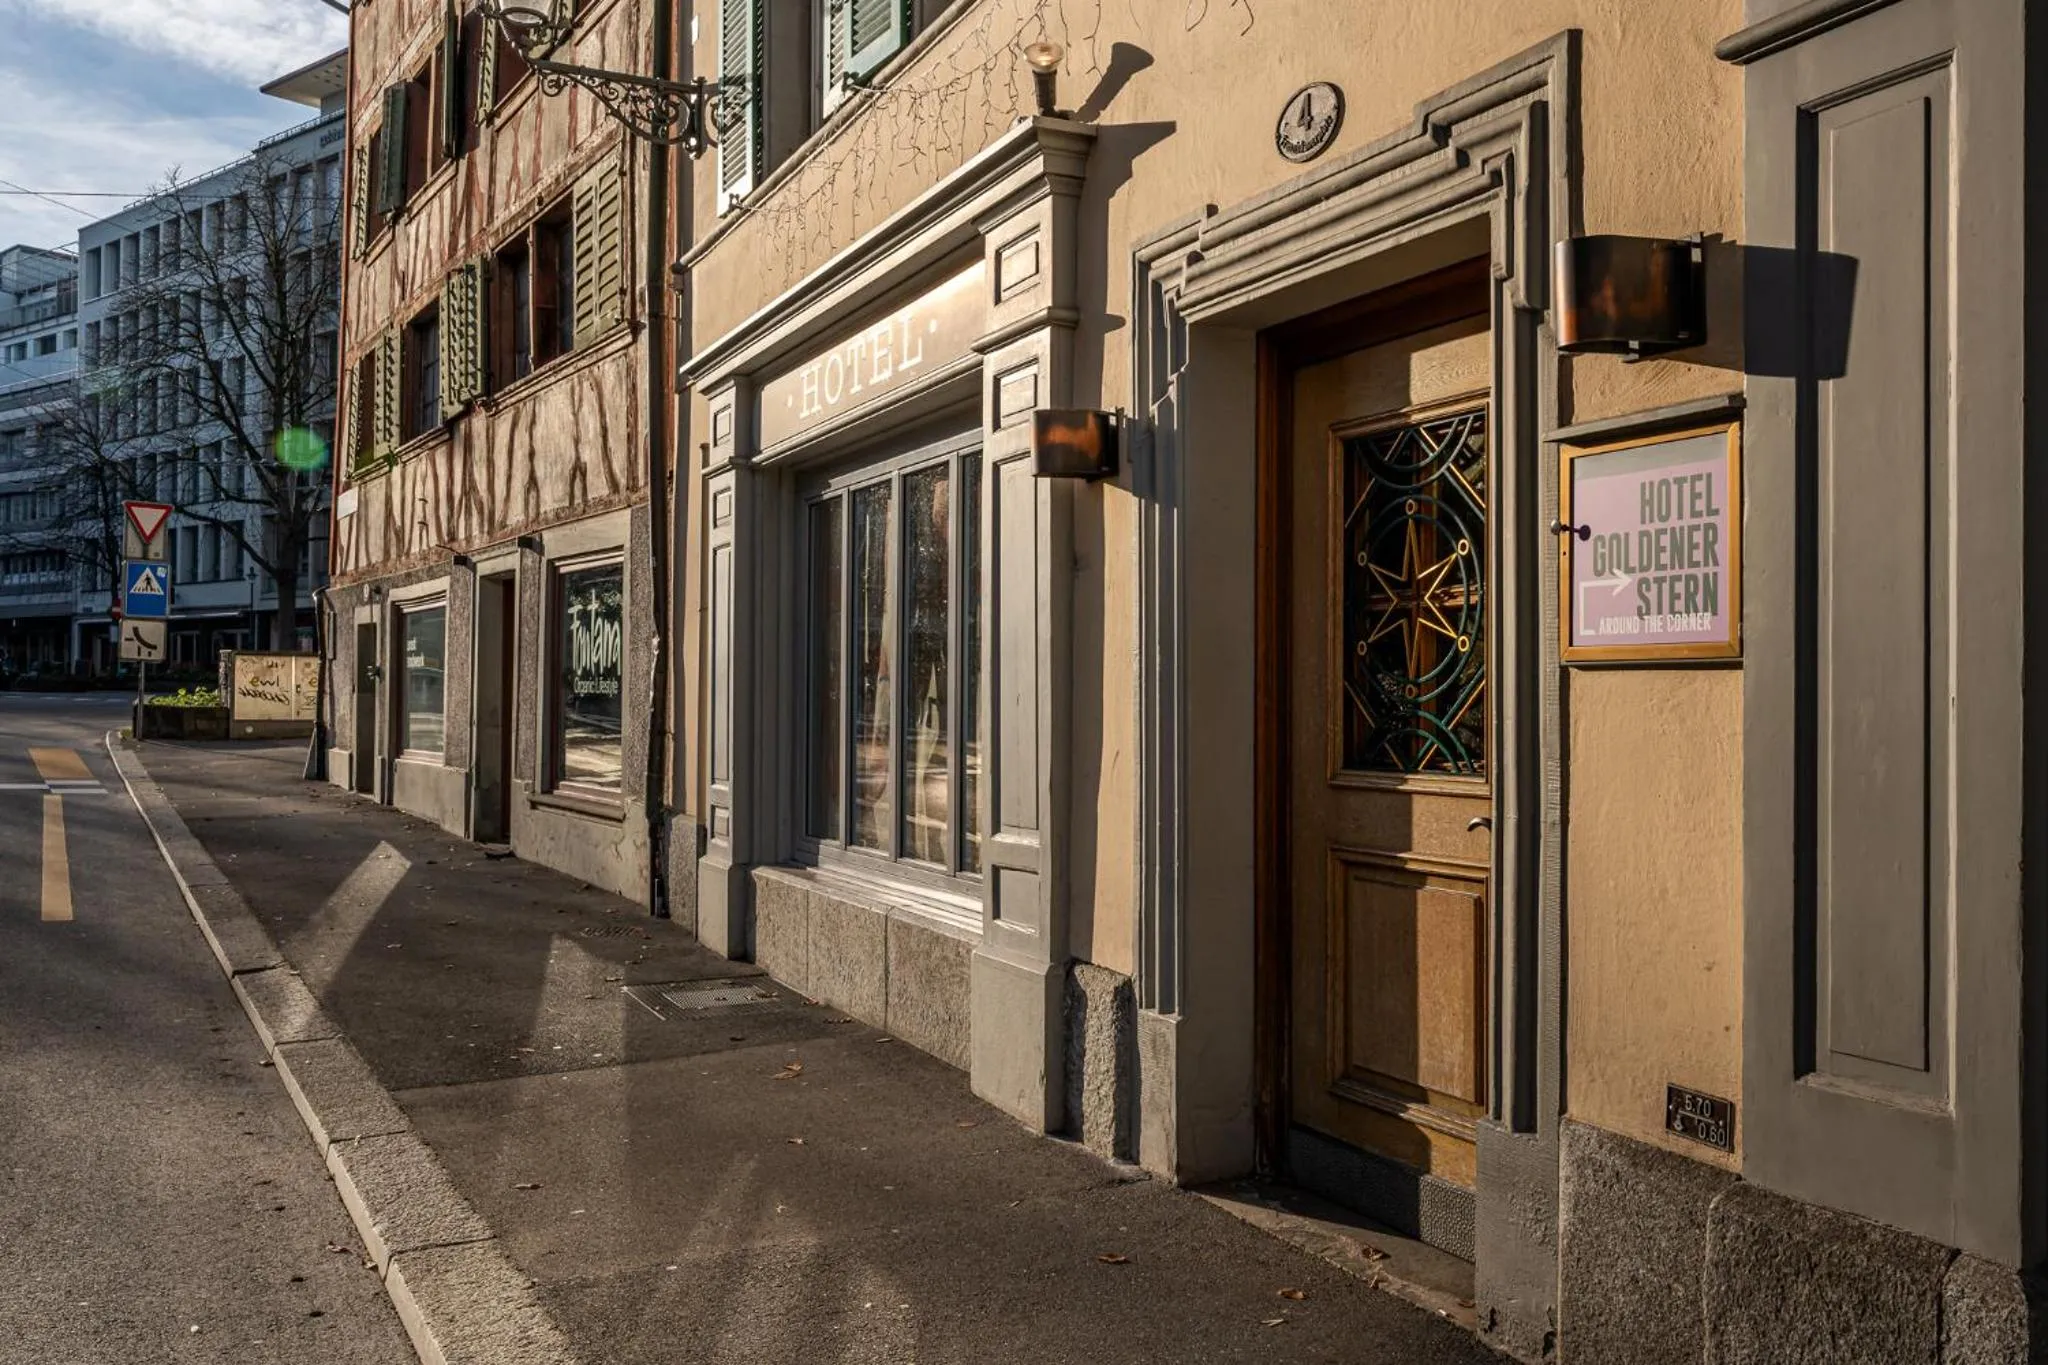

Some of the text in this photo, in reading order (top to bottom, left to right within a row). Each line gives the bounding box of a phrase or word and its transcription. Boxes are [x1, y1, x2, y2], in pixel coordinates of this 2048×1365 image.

[1297, 93, 1314, 131] 4
[799, 313, 922, 419] HOTEL
[1640, 472, 1720, 524] HOTEL
[1593, 522, 1720, 577] GOLDENER
[1637, 572, 1718, 620] STERN
[1599, 611, 1711, 635] AROUND THE CORNER
